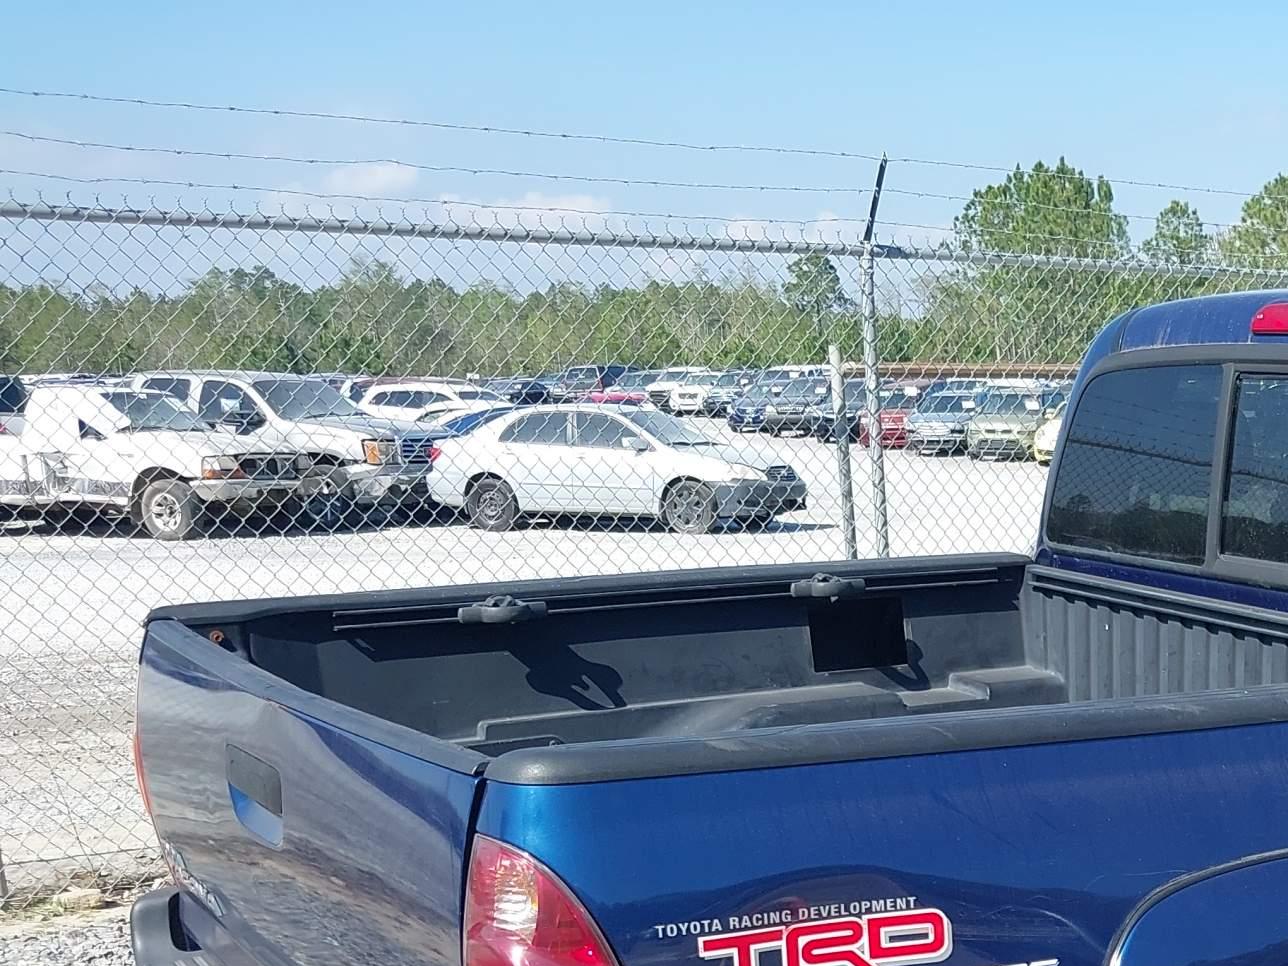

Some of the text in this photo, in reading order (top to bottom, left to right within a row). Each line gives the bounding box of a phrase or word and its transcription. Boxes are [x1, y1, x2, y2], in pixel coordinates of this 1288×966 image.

[655, 896, 918, 939] TOYOTA RACING DEVELOPMENT
